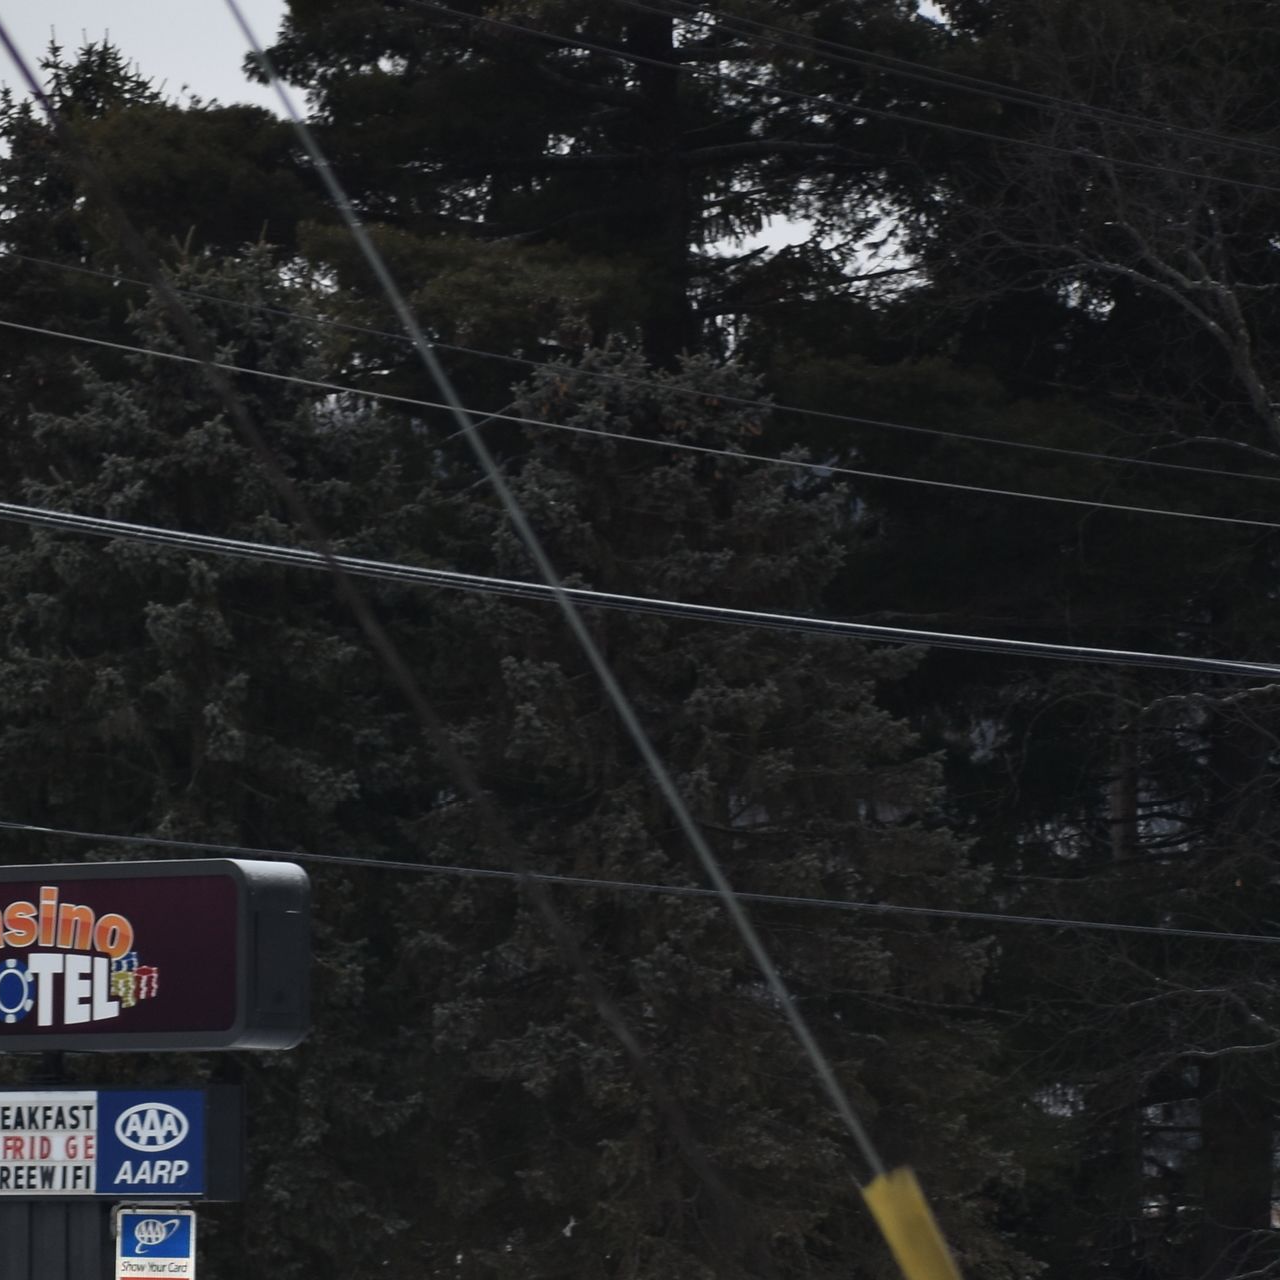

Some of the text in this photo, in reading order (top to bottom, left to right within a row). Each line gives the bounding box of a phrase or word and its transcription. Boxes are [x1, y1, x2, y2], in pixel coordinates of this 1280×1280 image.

[125, 1108, 179, 1146] AAA
[114, 1160, 190, 1184] AARP
[121, 1261, 188, 1273] Show Your Card
